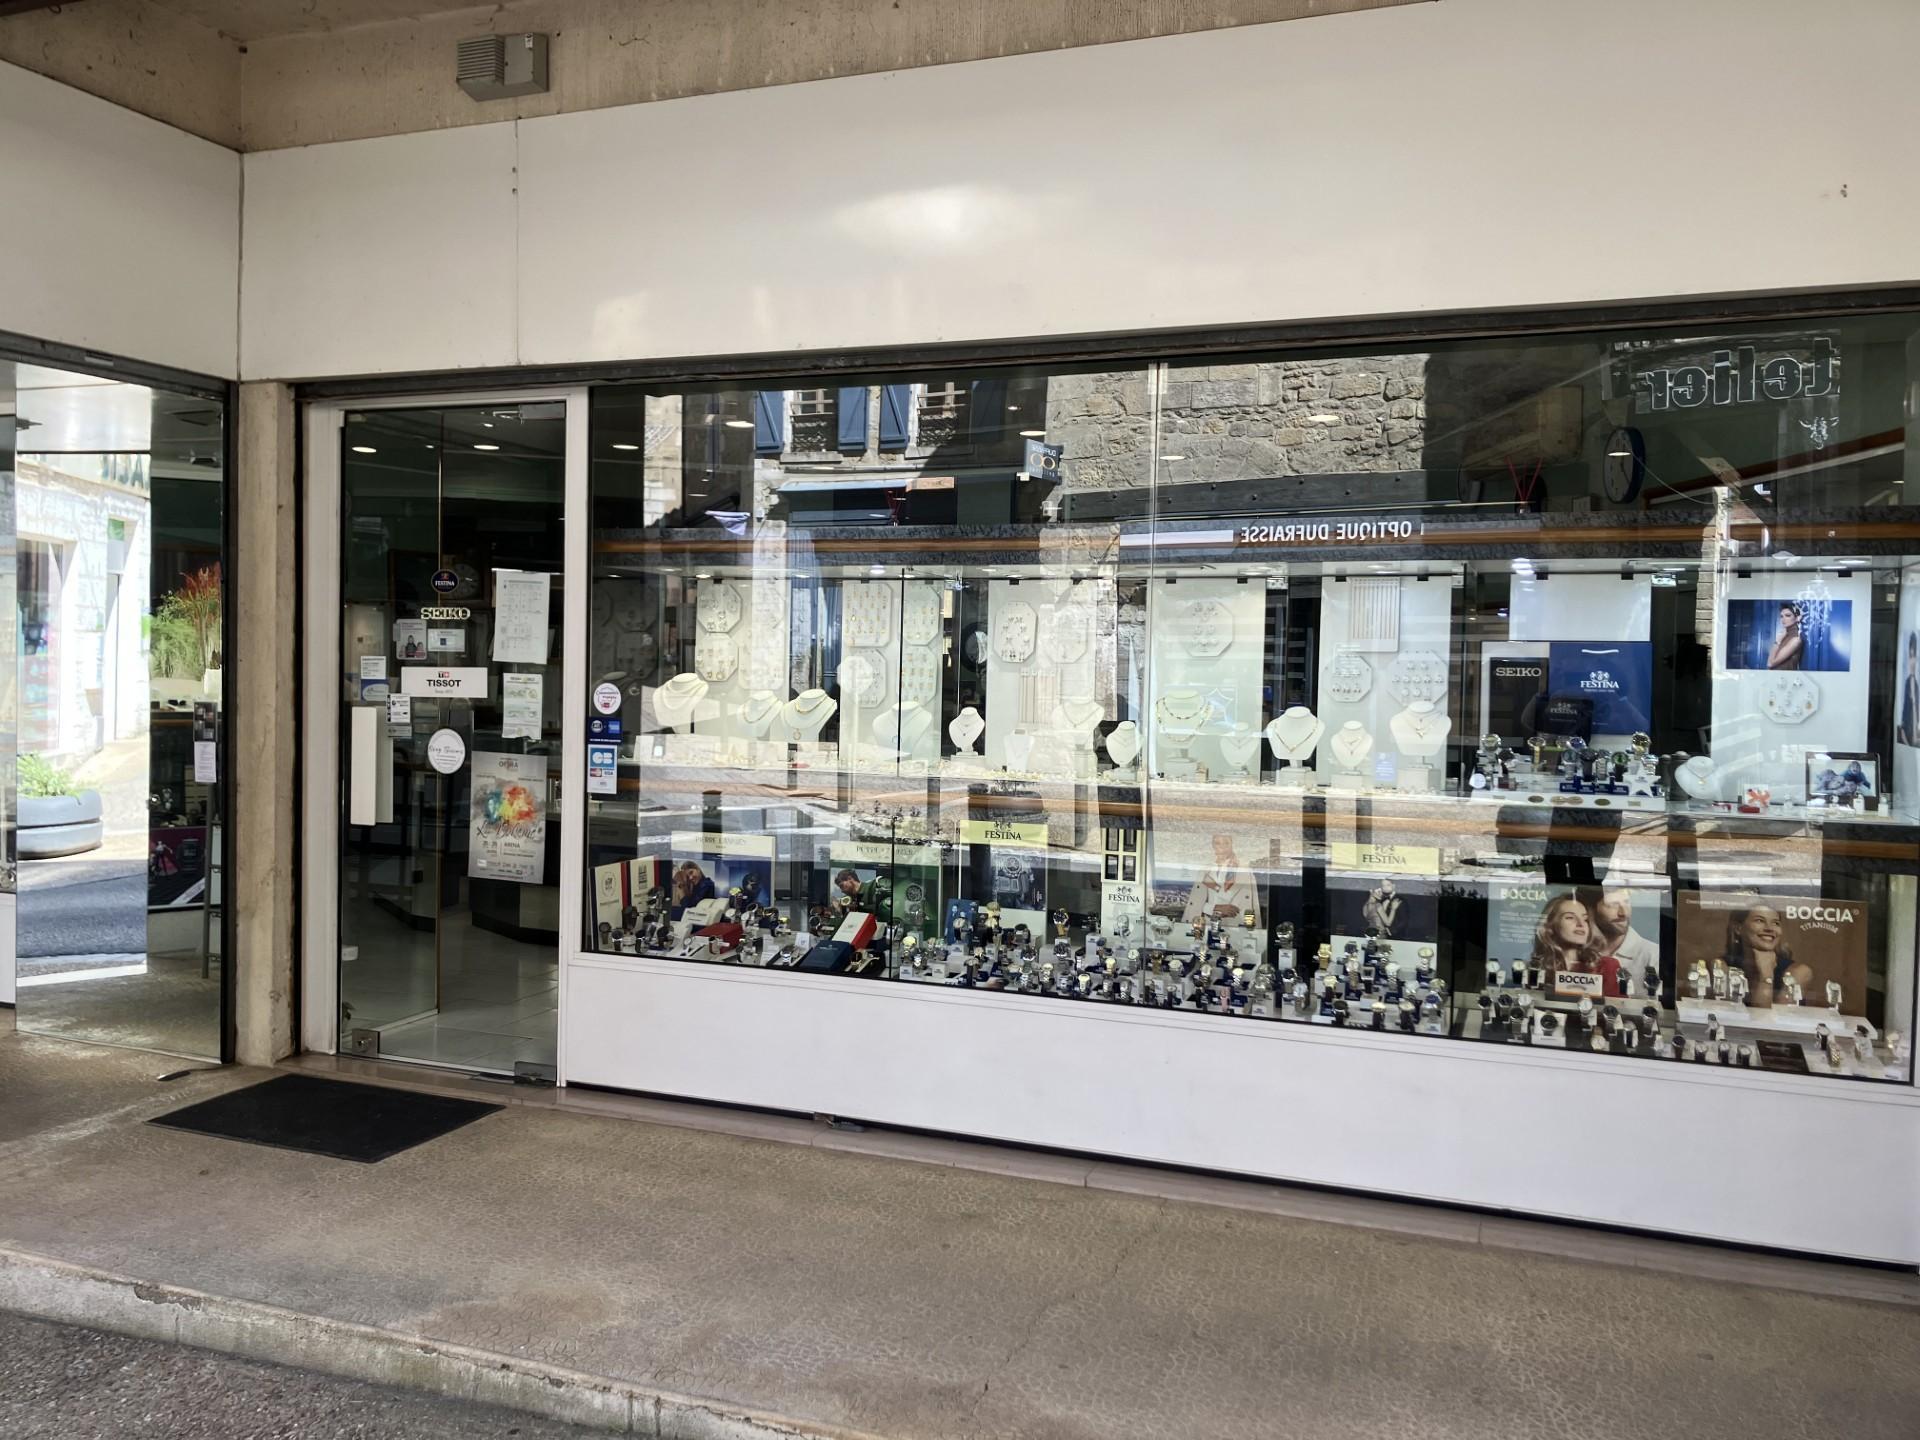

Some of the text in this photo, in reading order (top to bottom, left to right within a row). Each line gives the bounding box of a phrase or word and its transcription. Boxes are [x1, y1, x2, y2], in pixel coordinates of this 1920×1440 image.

[420, 606, 471, 620] SEIKO
[1495, 667, 1542, 677] SEIKO
[426, 679, 462, 688] TISSOT
[1579, 680, 1620, 689] FESTINA
[592, 751, 613, 764] CB
[984, 830, 1022, 841] FESTINA
[1362, 854, 1407, 865] FESTINA
[1108, 893, 1140, 903] FESTINA
[1499, 888, 1548, 901] BOCCIA
[1785, 904, 1855, 923] BOCCIA
[1799, 921, 1840, 935] TITANIUM
[1558, 974, 1596, 986] BOCCIA
